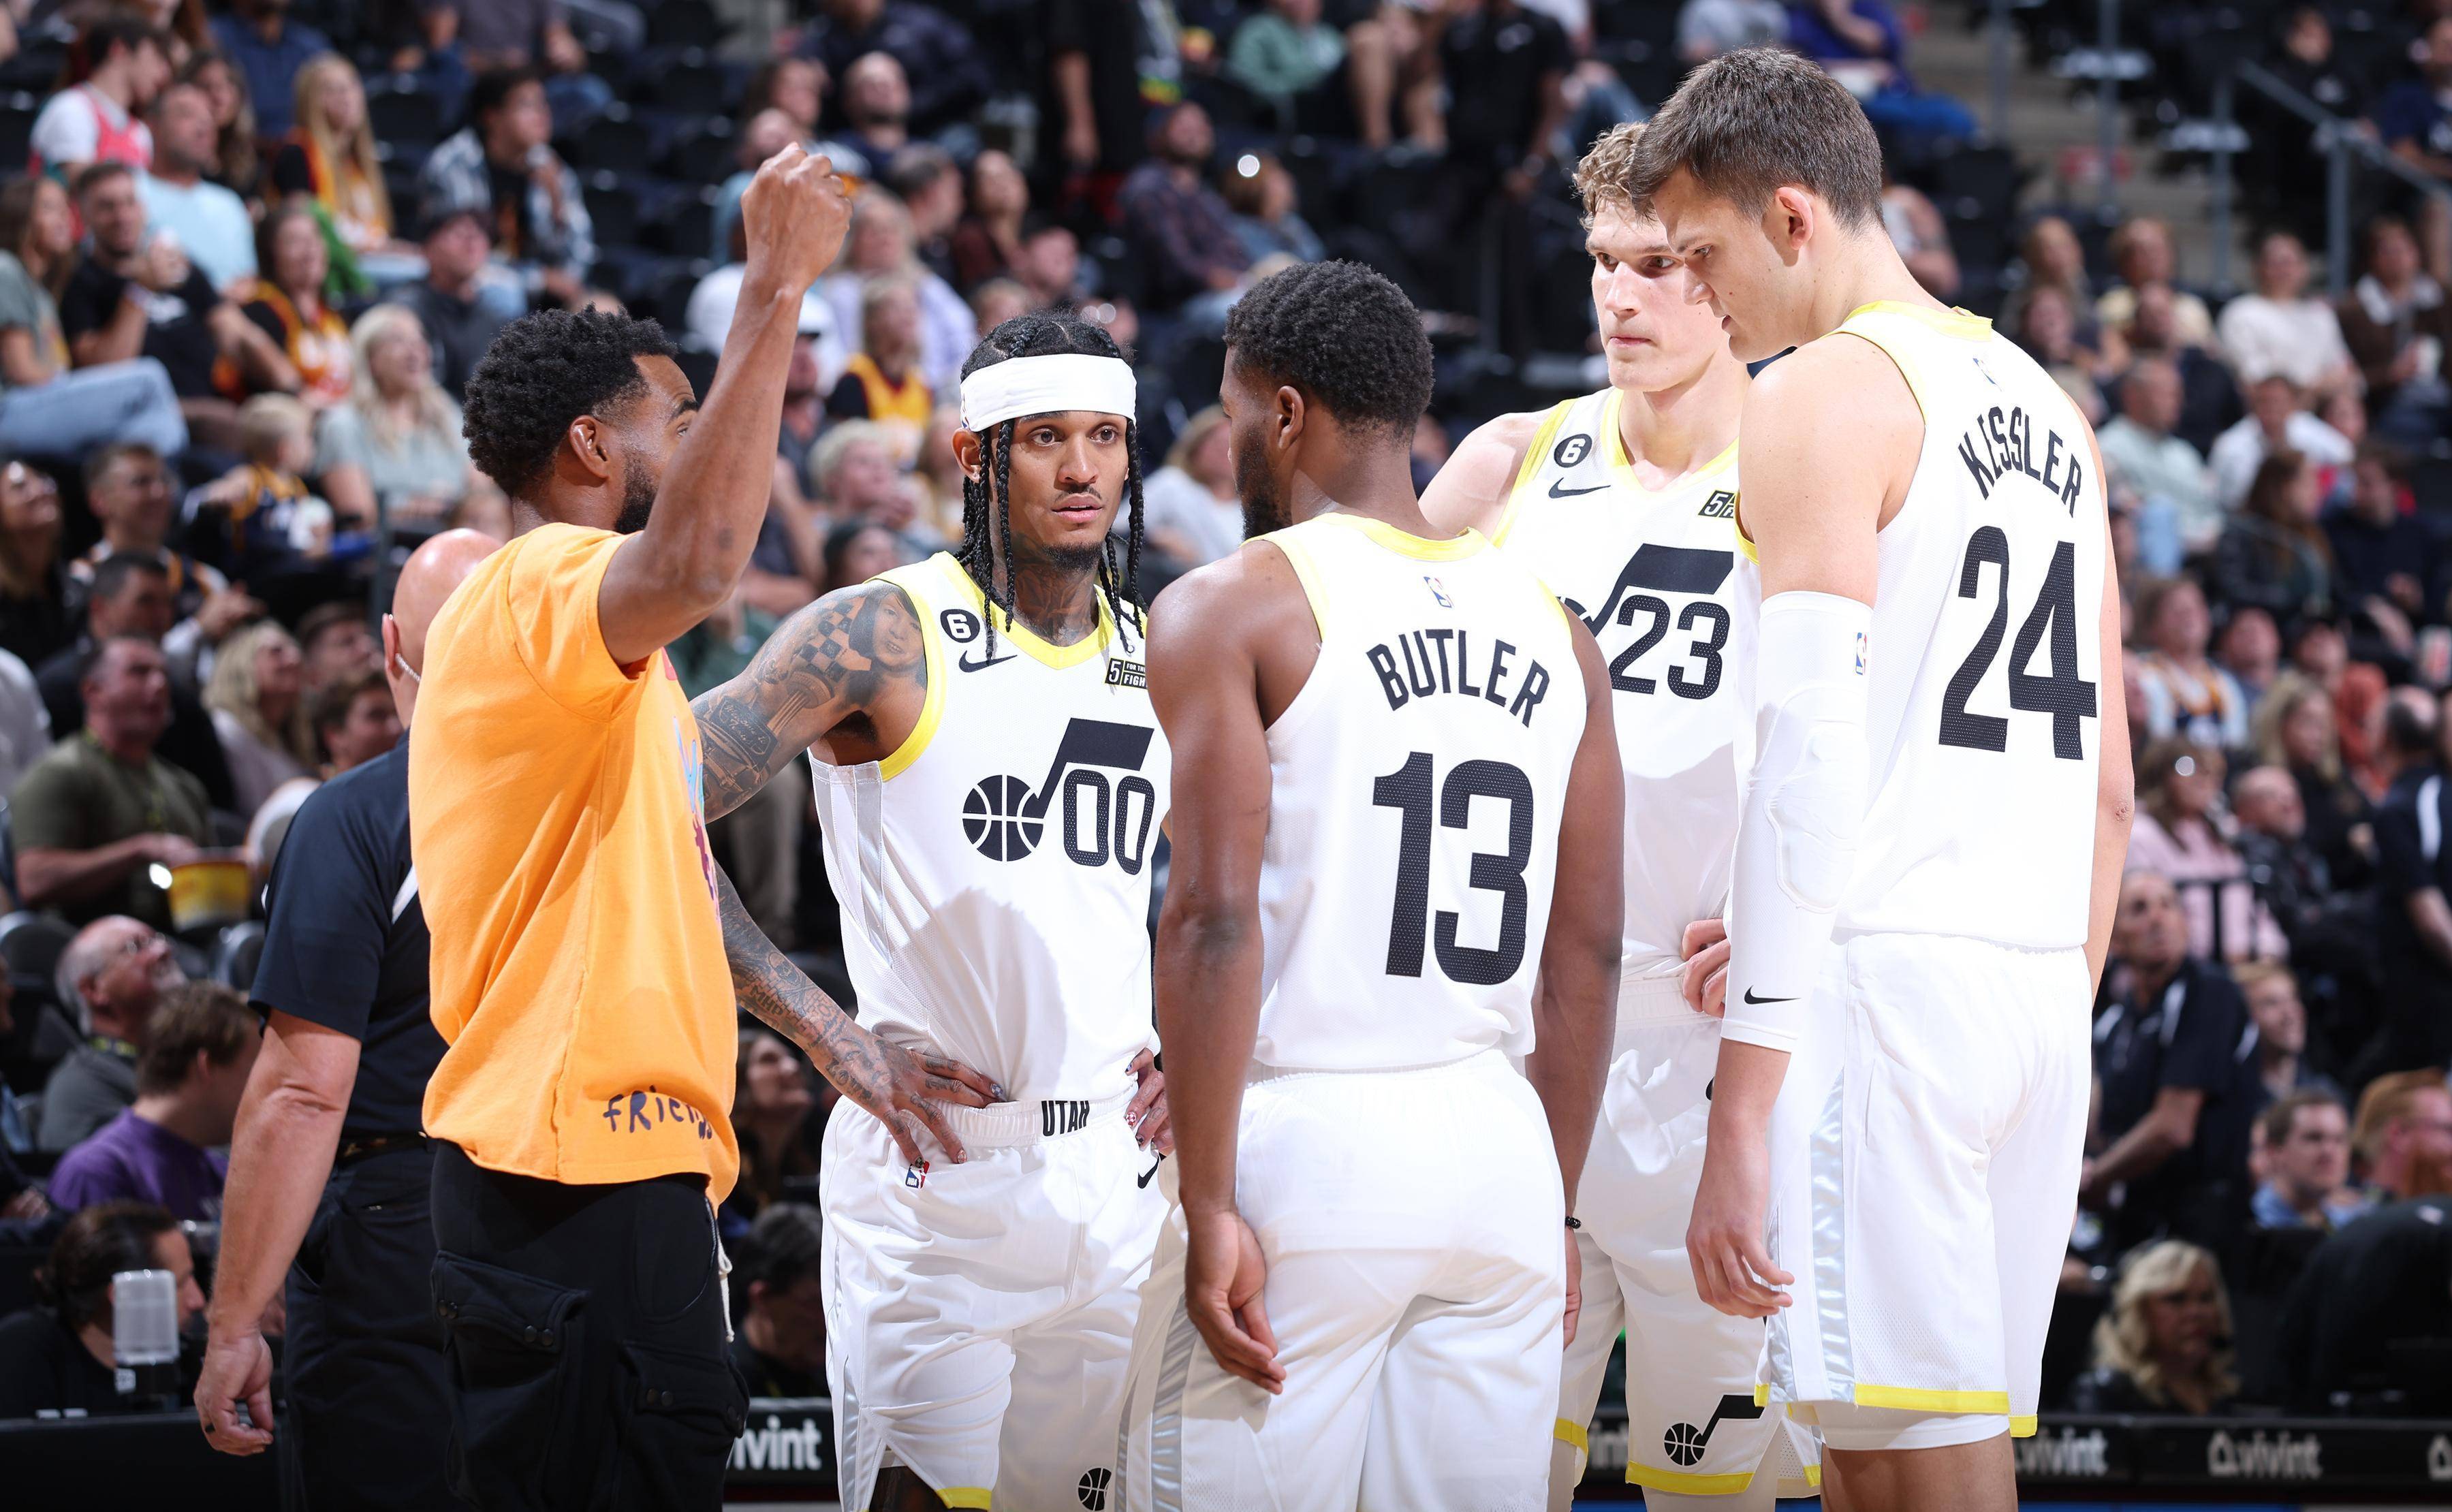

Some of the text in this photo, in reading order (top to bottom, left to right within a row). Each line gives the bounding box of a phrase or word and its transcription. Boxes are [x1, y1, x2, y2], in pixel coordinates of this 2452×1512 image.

[1560, 438, 1586, 463] 6
[1704, 493, 1729, 516] 5
[947, 614, 971, 638] 6
[1609, 595, 1730, 699] 23
[1939, 526, 2096, 759] 24
[1108, 661, 1121, 683] 5
[1123, 674, 1147, 688] FIGH
[1127, 663, 1137, 671] FOR
[1367, 629, 1550, 727] BUTLER
[1063, 769, 1154, 875] 00
[1372, 751, 1533, 985] 13
[1041, 1100, 1090, 1137] UTAH
[907, 1177, 917, 1186] NBA
[734, 1414, 822, 1470] ivint
